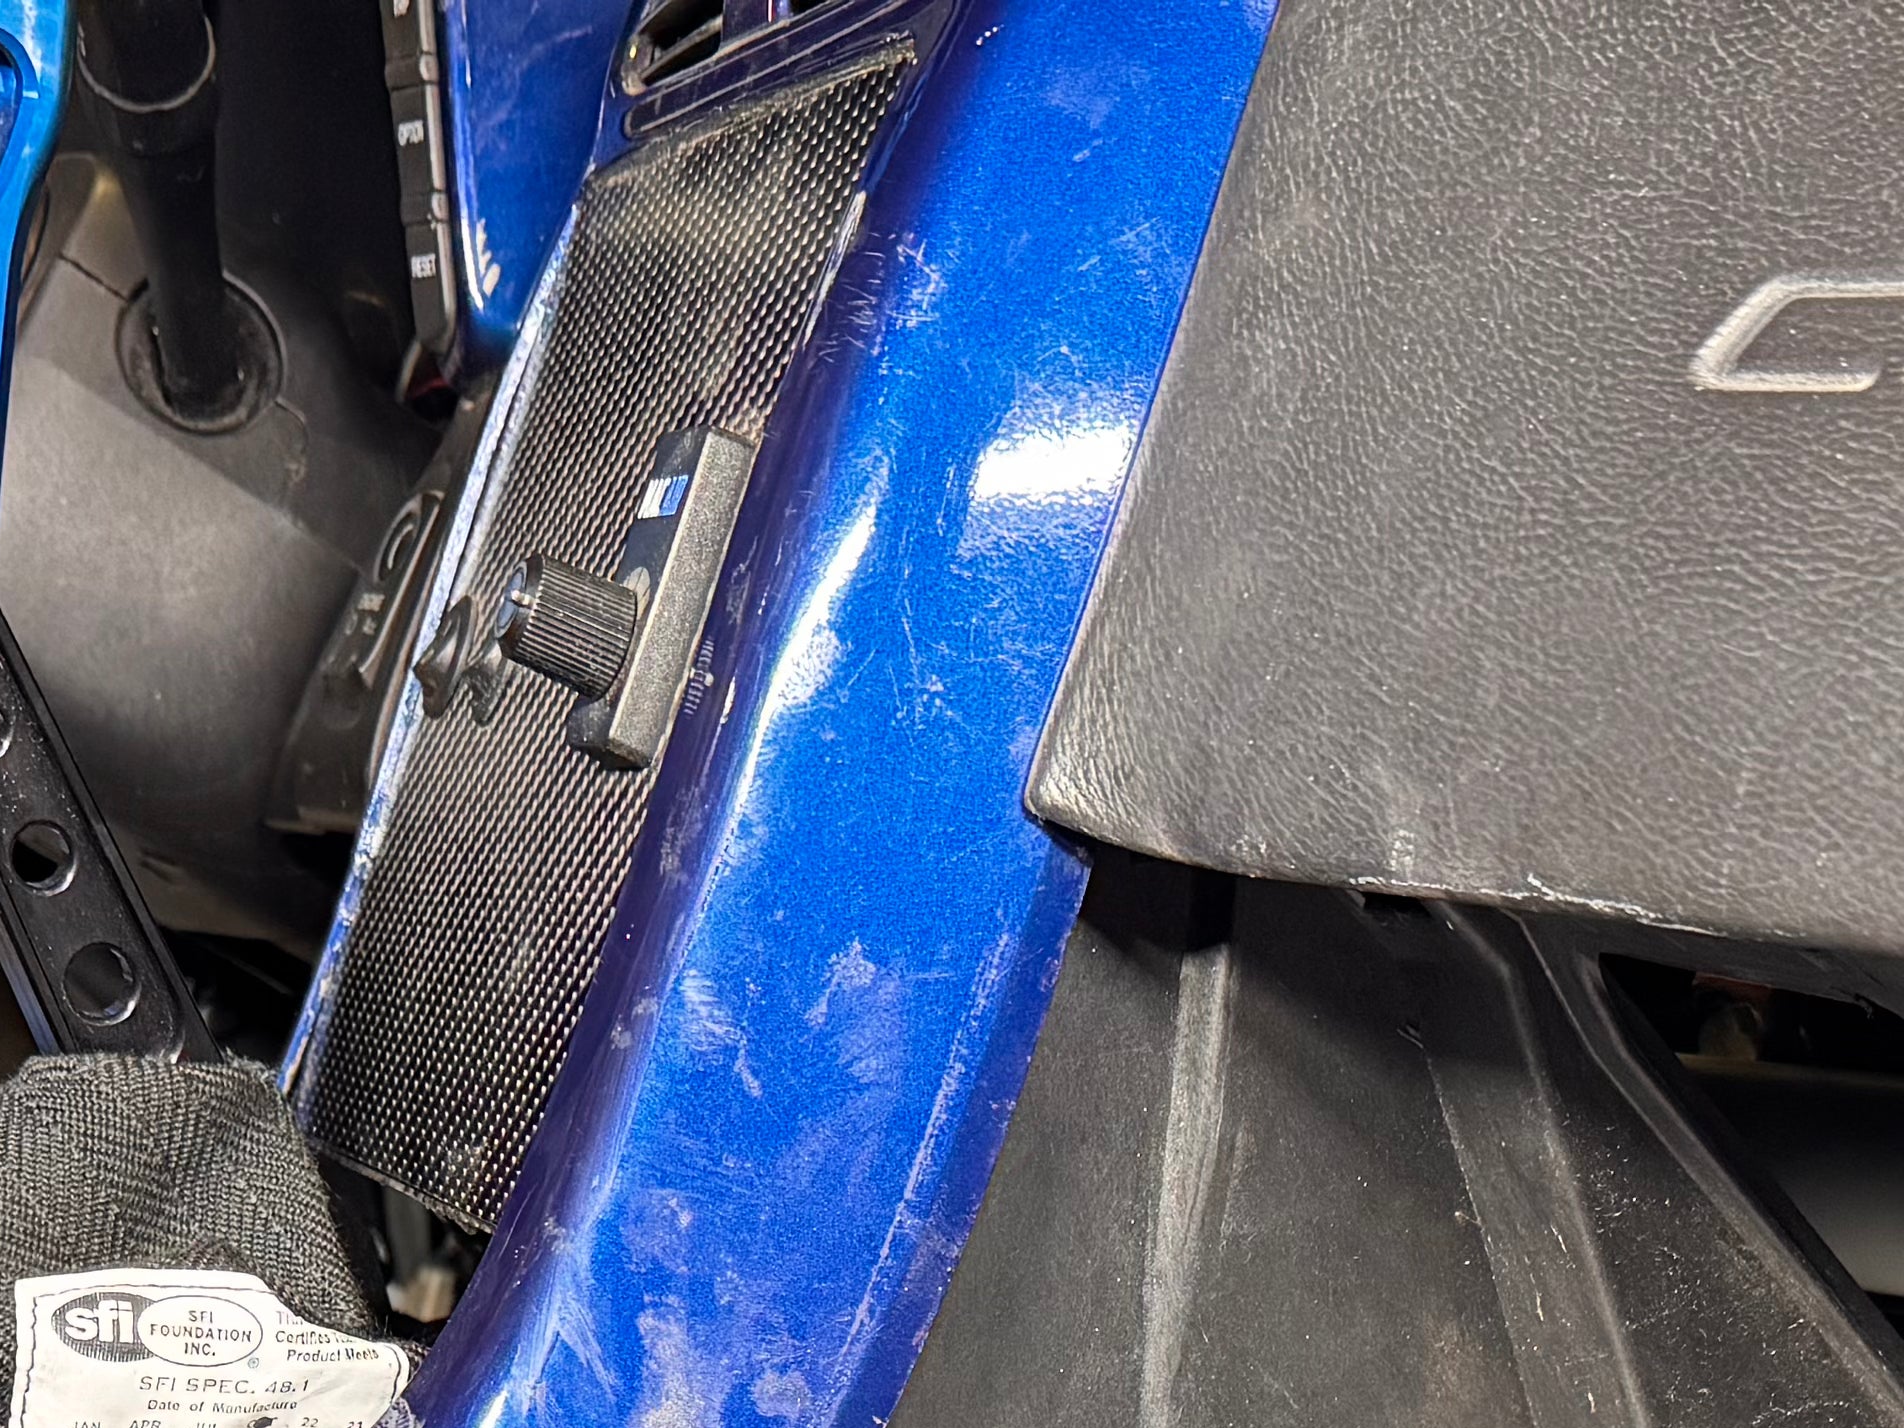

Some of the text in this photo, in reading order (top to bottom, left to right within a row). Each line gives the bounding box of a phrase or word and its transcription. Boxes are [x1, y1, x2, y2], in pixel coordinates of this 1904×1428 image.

[64, 1299, 134, 1344] sfi
[188, 1310, 214, 1324] SFI
[150, 1323, 252, 1343] FOUNDATION
[184, 1342, 216, 1357] INC.
[287, 1349, 341, 1362] Product
[139, 1376, 309, 1394] SFI SPEC. 48.1
[147, 1400, 298, 1414] Date of Manufacture
[301, 1417, 319, 1428] 22
